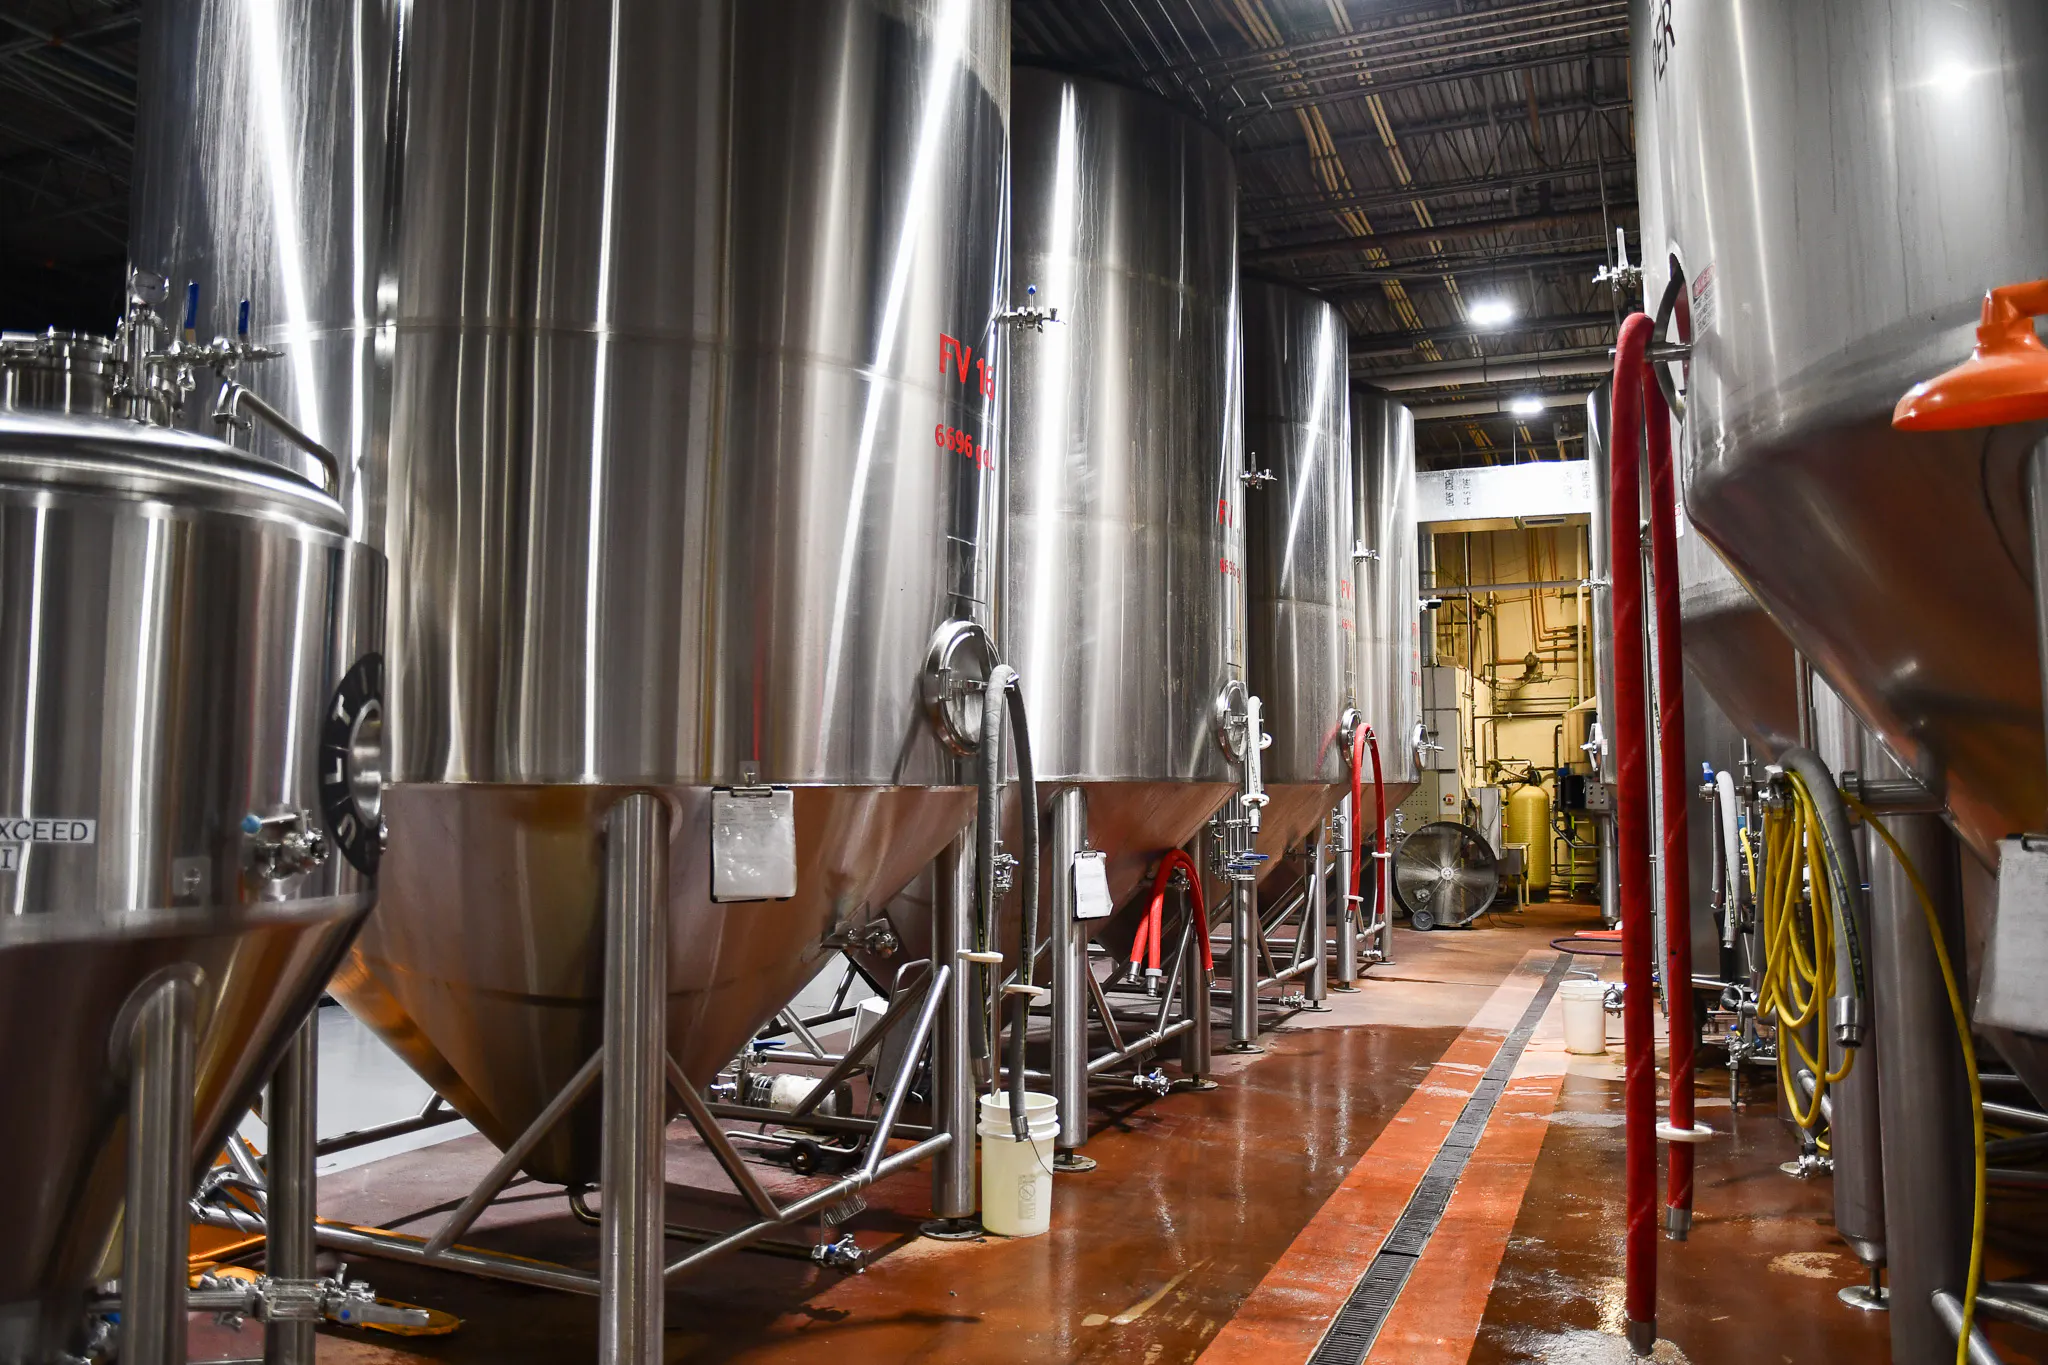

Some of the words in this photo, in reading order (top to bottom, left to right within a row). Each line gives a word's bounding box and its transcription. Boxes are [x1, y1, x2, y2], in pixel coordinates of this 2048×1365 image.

[939, 332, 972, 384] FV
[976, 357, 995, 401] 16
[934, 423, 973, 459] 6696
